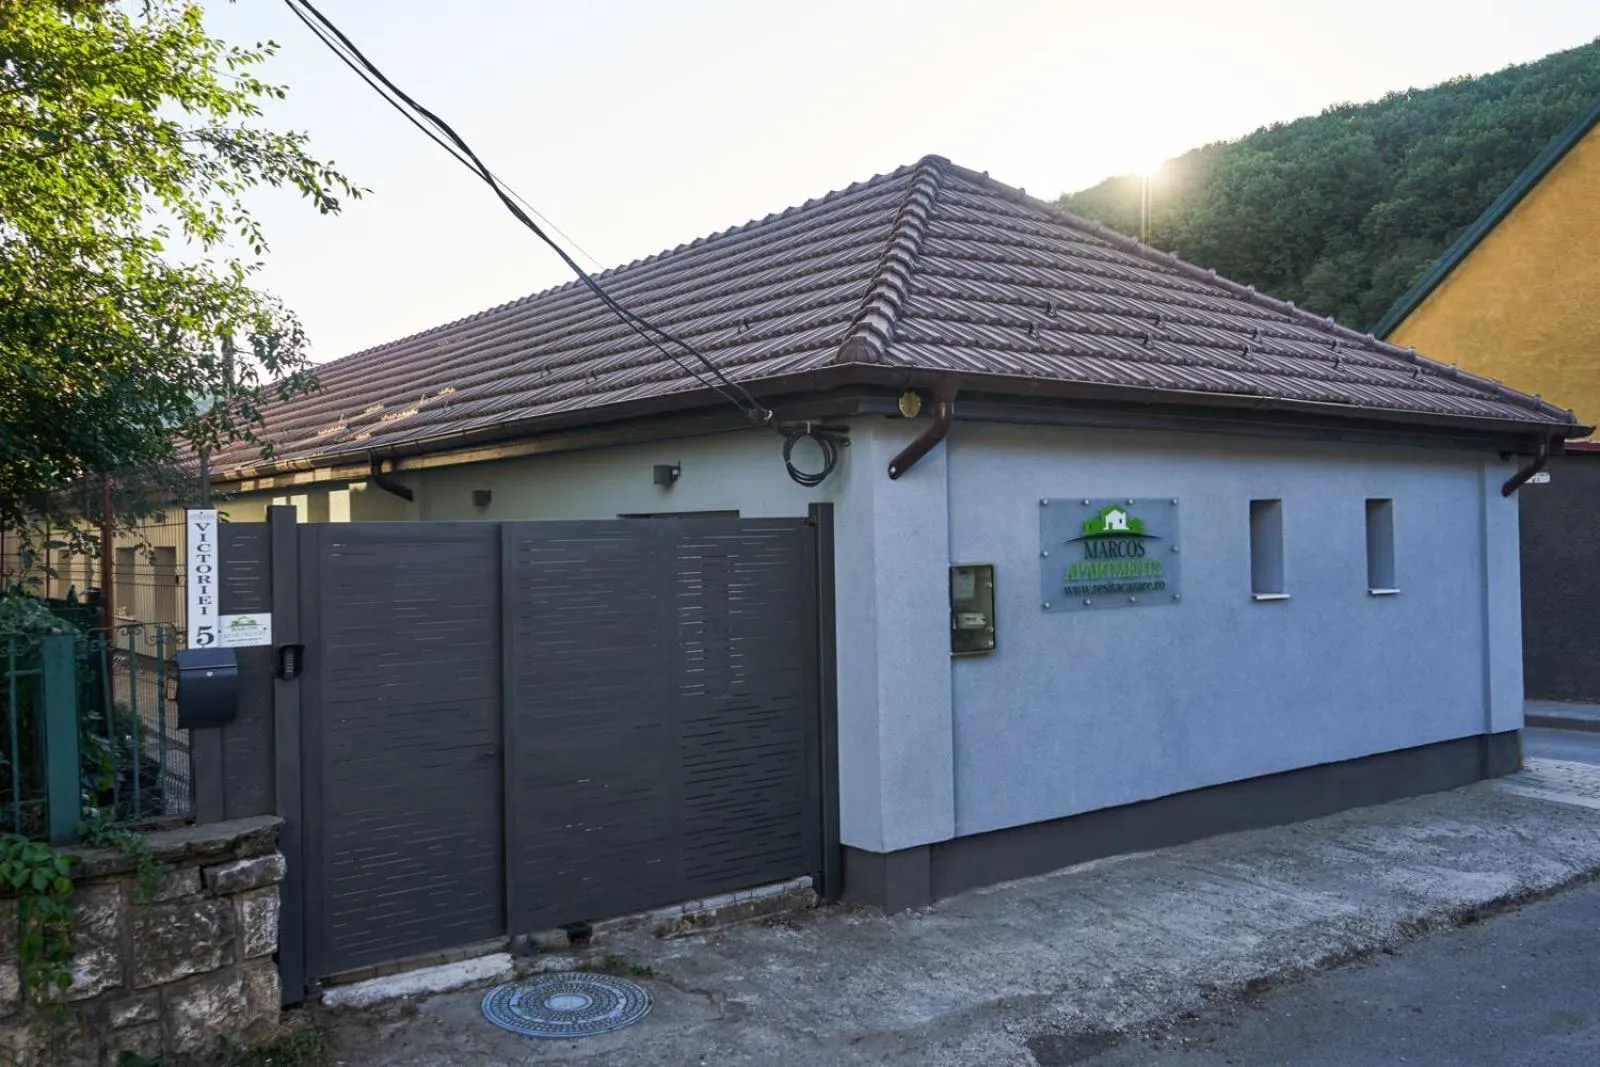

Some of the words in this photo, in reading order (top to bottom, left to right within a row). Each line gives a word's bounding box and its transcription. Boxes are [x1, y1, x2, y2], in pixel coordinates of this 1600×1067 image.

[1084, 540, 1146, 559] MARCOS
[195, 522, 212, 615] VICTORIEI
[196, 625, 214, 646] 5
